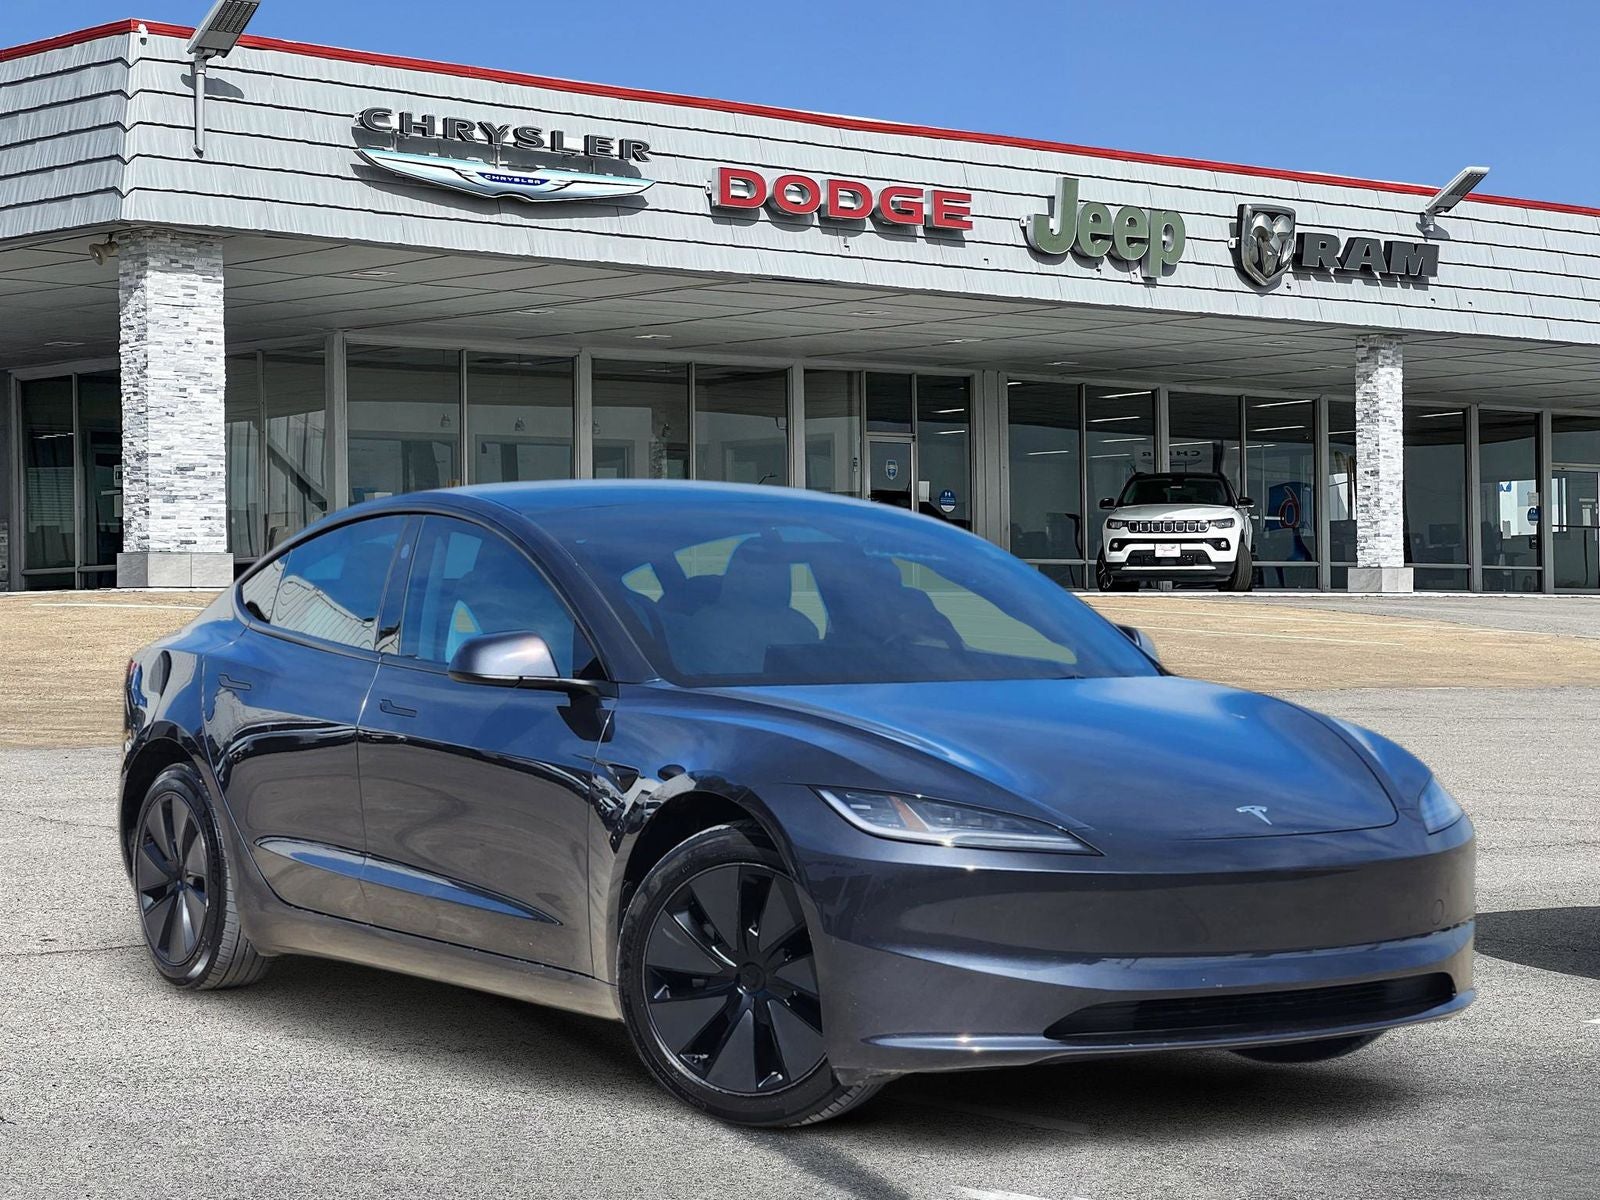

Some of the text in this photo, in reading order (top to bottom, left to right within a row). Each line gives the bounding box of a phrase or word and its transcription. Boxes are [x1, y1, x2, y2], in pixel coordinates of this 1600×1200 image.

[358, 107, 651, 162] CHRYSLER
[484, 174, 541, 185] CHRYSLER
[713, 167, 973, 231] DODGE
[1027, 177, 1186, 278] Jeep
[1297, 232, 1439, 277] RAM
